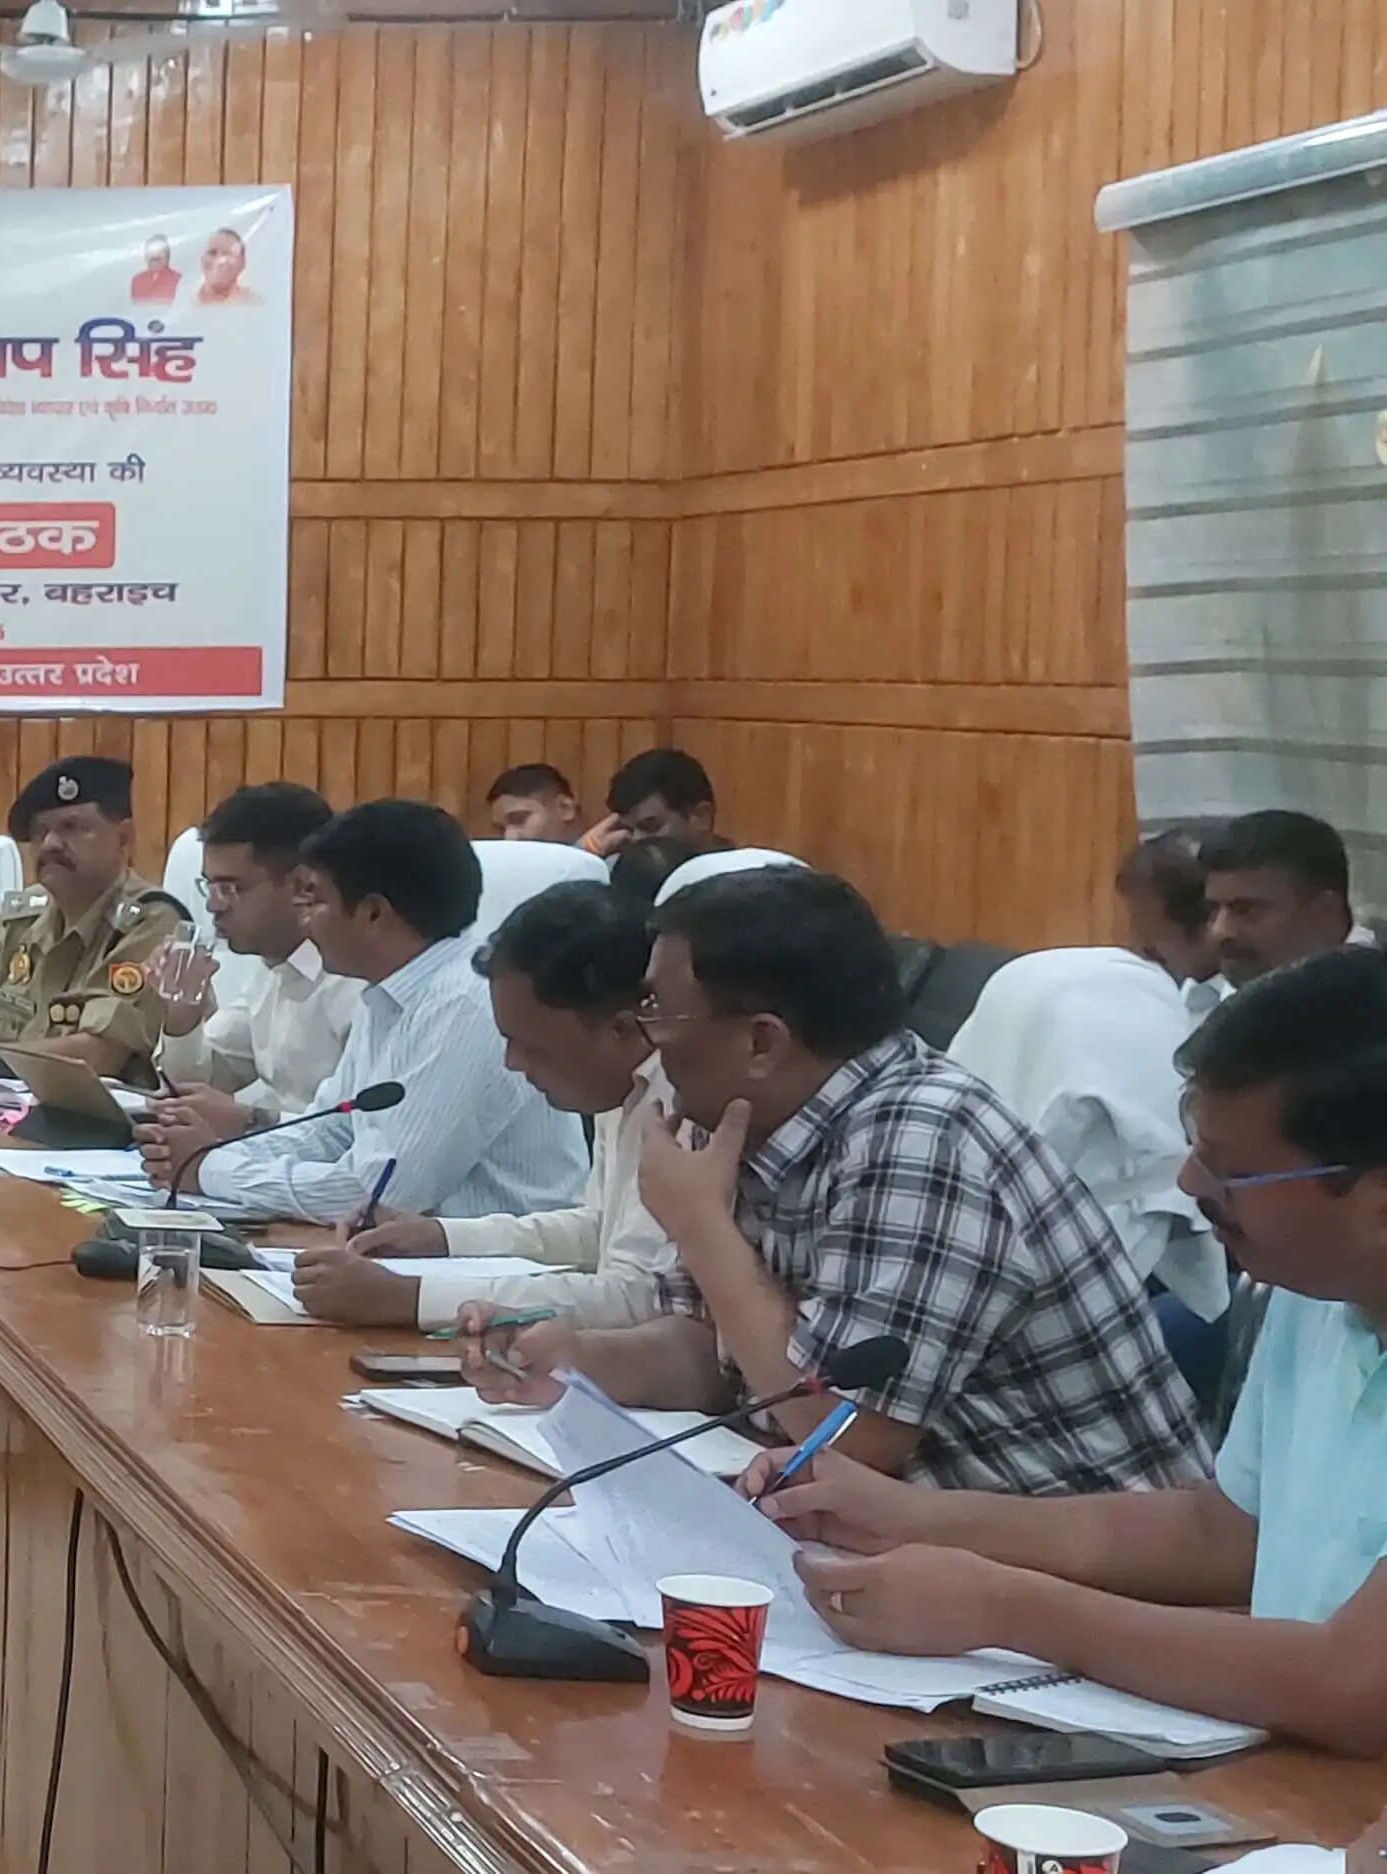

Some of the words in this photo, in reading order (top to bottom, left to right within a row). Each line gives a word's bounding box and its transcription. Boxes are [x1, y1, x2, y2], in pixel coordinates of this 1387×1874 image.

[75, 317, 203, 383] सिंह
[107, 453, 145, 484] की
[44, 582, 179, 606] बहराइच
[75, 655, 140, 685] प्रदेश
